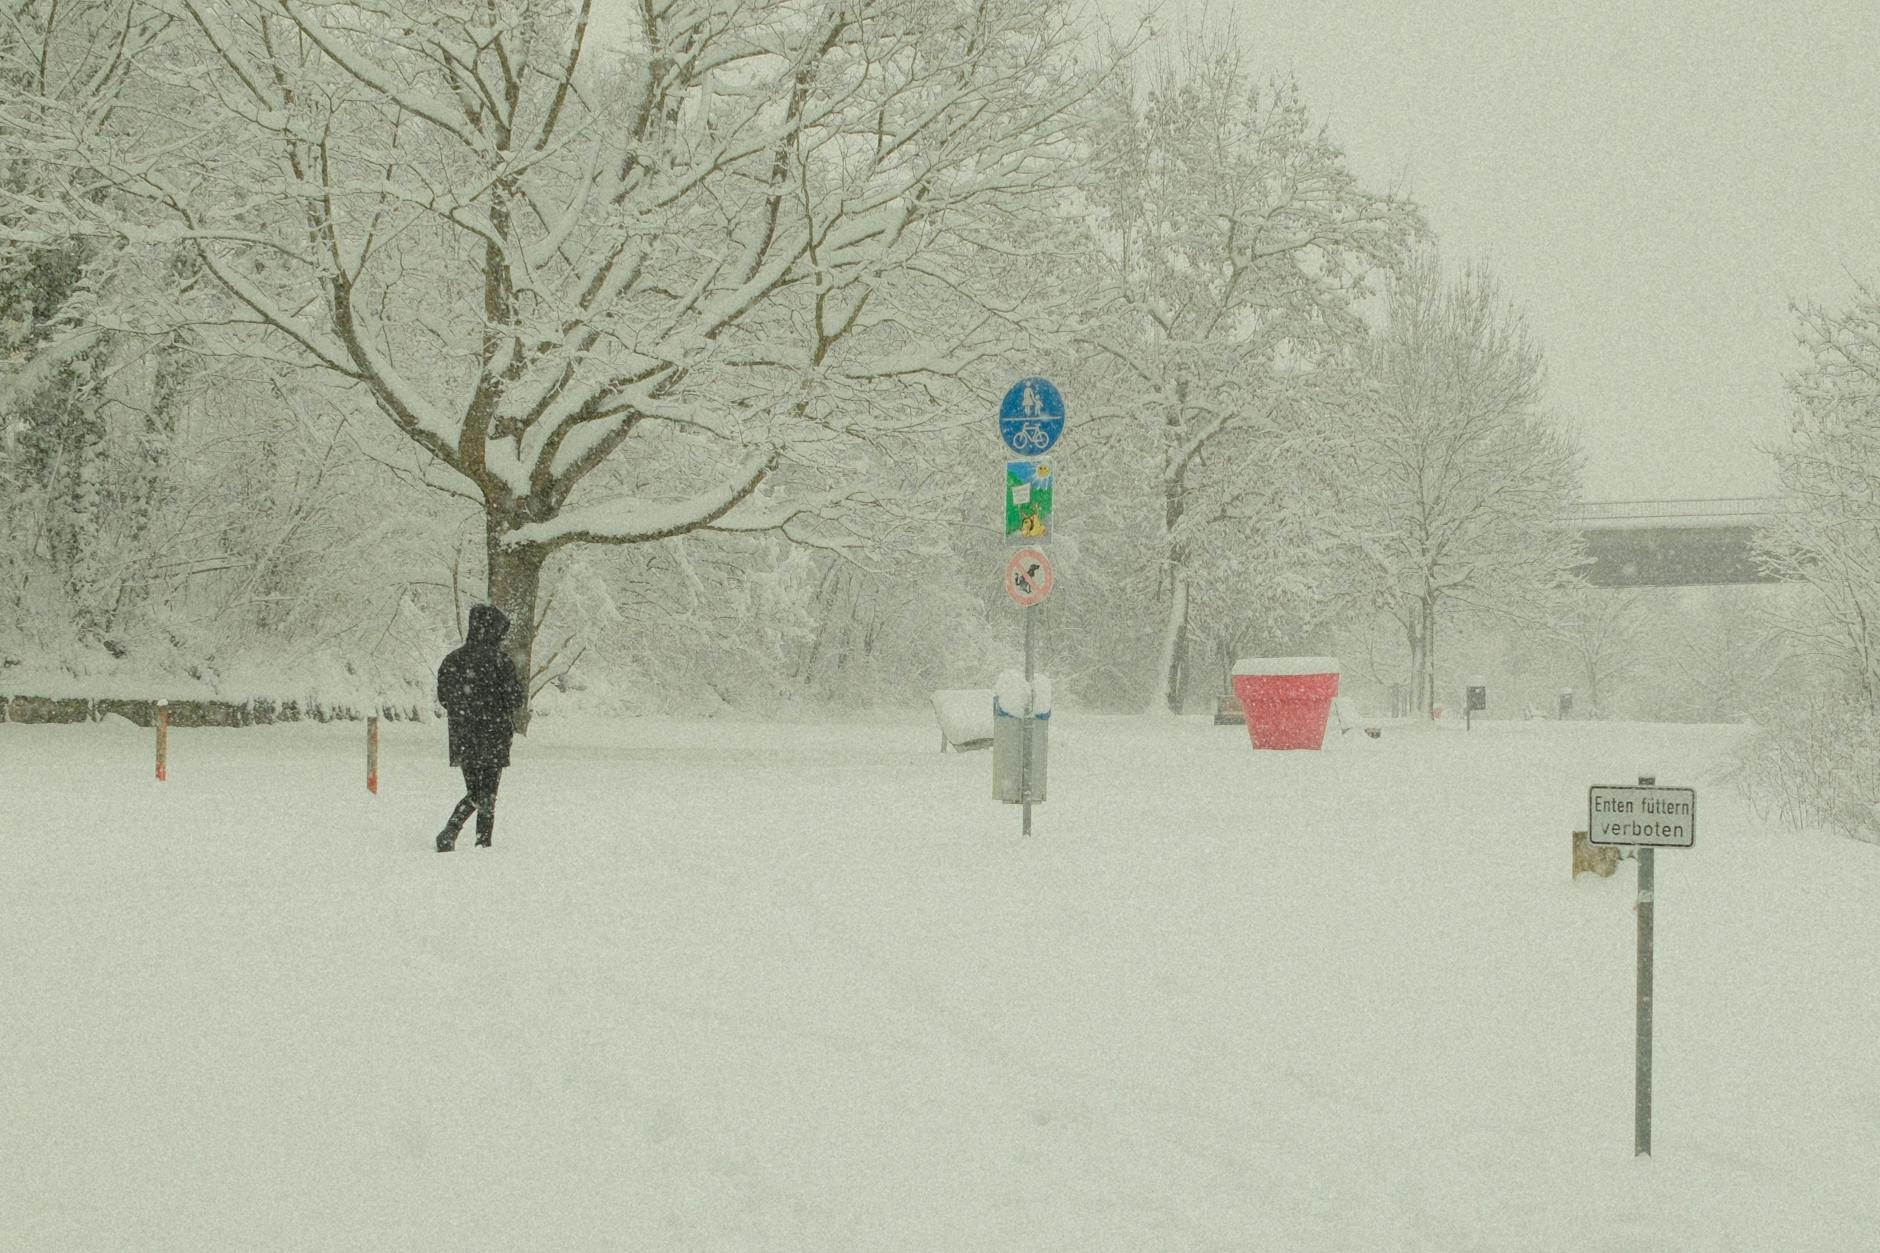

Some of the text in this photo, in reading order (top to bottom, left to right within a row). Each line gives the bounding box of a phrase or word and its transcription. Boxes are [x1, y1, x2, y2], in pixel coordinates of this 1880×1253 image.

[1595, 795, 1689, 815] Enten füttern
[1602, 820, 1684, 837] verboten
